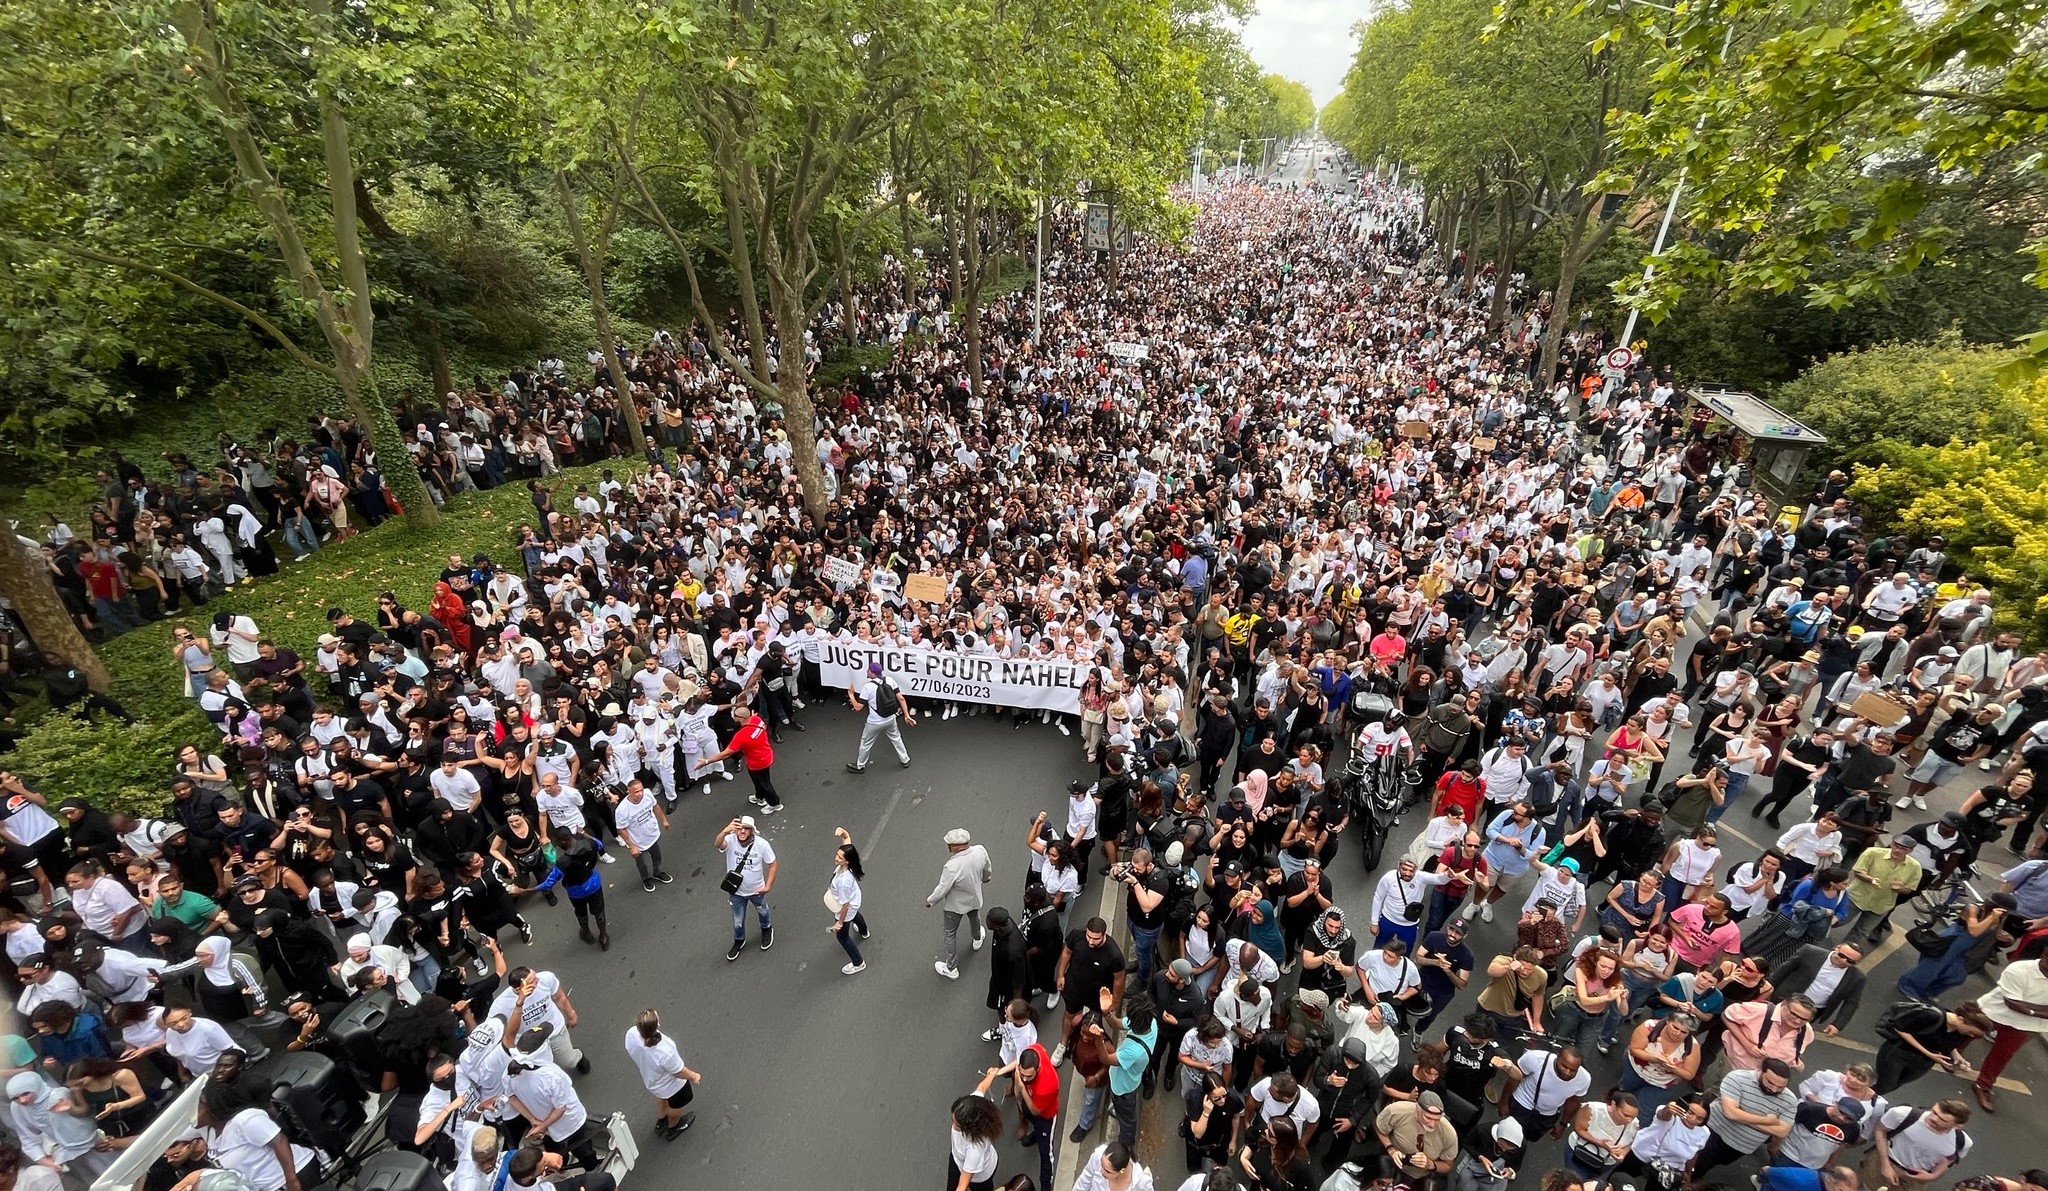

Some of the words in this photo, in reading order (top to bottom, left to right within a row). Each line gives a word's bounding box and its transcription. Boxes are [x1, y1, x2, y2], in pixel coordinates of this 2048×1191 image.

[823, 645, 918, 673] JUSTICE
[926, 655, 992, 683] POUR
[1002, 663, 1081, 690] NAHEL
[911, 677, 991, 699] 27/06/2023
[1376, 743, 1393, 756] 91
